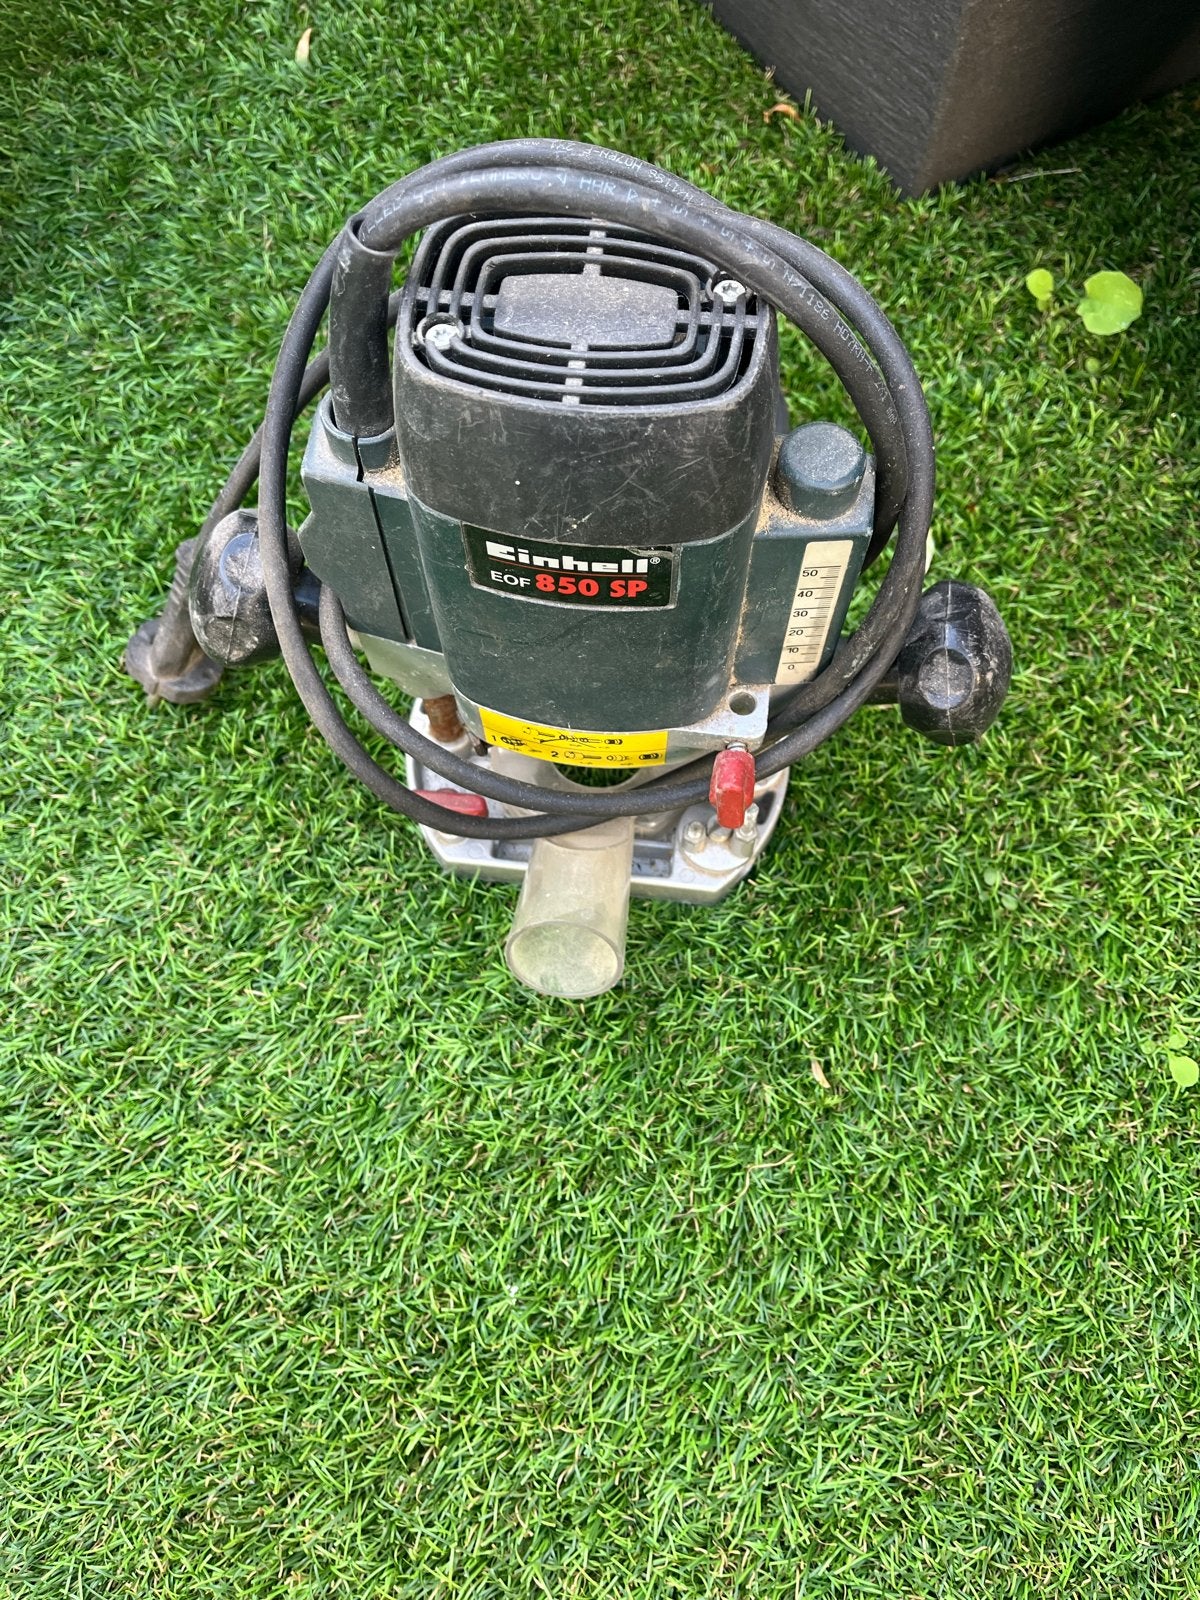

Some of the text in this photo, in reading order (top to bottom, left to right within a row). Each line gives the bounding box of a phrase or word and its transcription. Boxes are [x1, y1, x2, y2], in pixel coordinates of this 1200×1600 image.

[802, 569, 819, 577] 50
[490, 570, 649, 598] EOF 850 SP
[797, 590, 813, 598] 40
[792, 610, 808, 618] 30
[551, 750, 559, 758] 2
